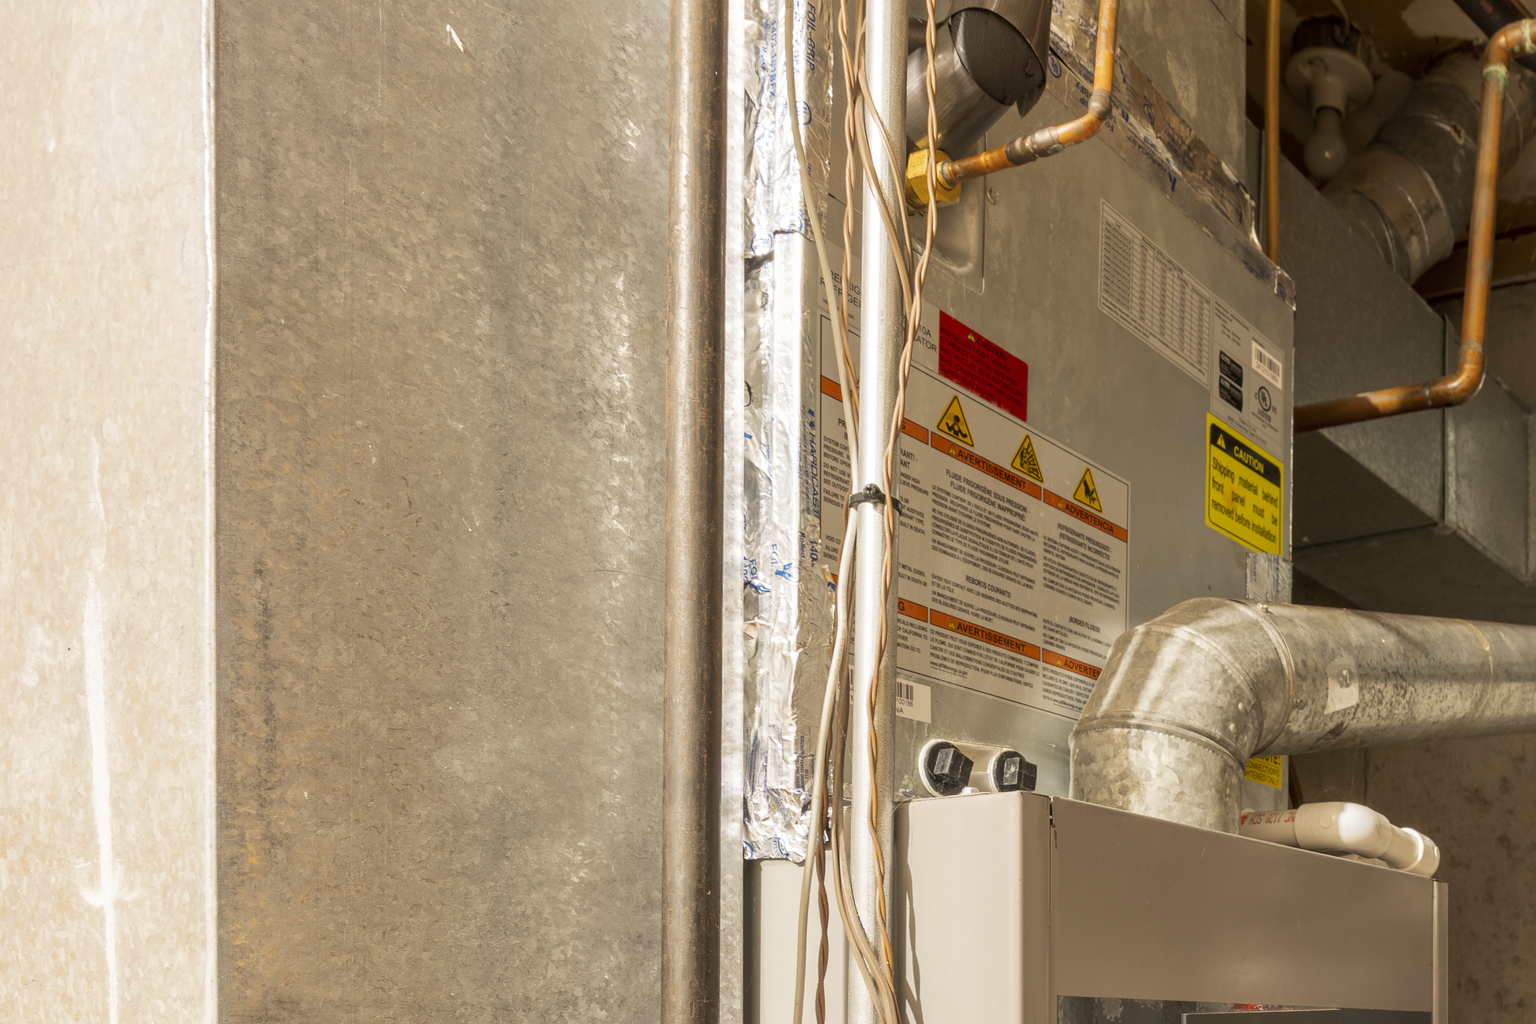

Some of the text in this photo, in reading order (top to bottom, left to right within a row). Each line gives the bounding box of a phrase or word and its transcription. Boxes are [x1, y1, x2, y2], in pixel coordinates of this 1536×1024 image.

[806, 2, 816, 71] FOIL-GRIP
[939, 334, 969, 358] CORRECT
[970, 353, 991, 372] PISTON
[992, 366, 1005, 380] SIZE
[1005, 374, 1017, 387] PER
[940, 325, 972, 351] INSTALLER
[973, 345, 989, 362] MUST
[990, 355, 1010, 374] VERIFY
[975, 335, 1007, 362] CAUTION
[939, 344, 983, 376] INSTRUCTIONS
[991, 375, 1025, 401] ACCESSORY
[939, 362, 975, 389] SUPERHEAT
[955, 362, 980, 384] CHARGE
[981, 378, 1004, 397] SYSTEM
[1005, 391, 1022, 408] USING
[823, 435, 840, 447] SYSTEM
[823, 451, 839, 464] BEFORE
[809, 432, 820, 516] HARDCAST
[830, 464, 838, 474] NOT
[957, 447, 1026, 491] AVERTISSEMENT
[1233, 443, 1264, 476] CAUTION
[823, 487, 839, 500] FAILURE
[910, 482, 929, 497] PRESSURE
[945, 468, 962, 483] FLUIDE
[993, 490, 1005, 503] SOUS
[950, 480, 966, 495] FLUIDE
[1212, 454, 1278, 510] Shipping material behind
[1064, 501, 1114, 534] ADVERTENCIA
[1211, 474, 1277, 528] front panel must be
[1211, 492, 1277, 549] removed before installation
[901, 562, 913, 573] METAL
[964, 573, 987, 590] REBORDS
[956, 620, 1025, 654] AVERTISSEMENT
[1063, 657, 1102, 680] ADVERTEN
[1267, 775, 1280, 786] ONLY
